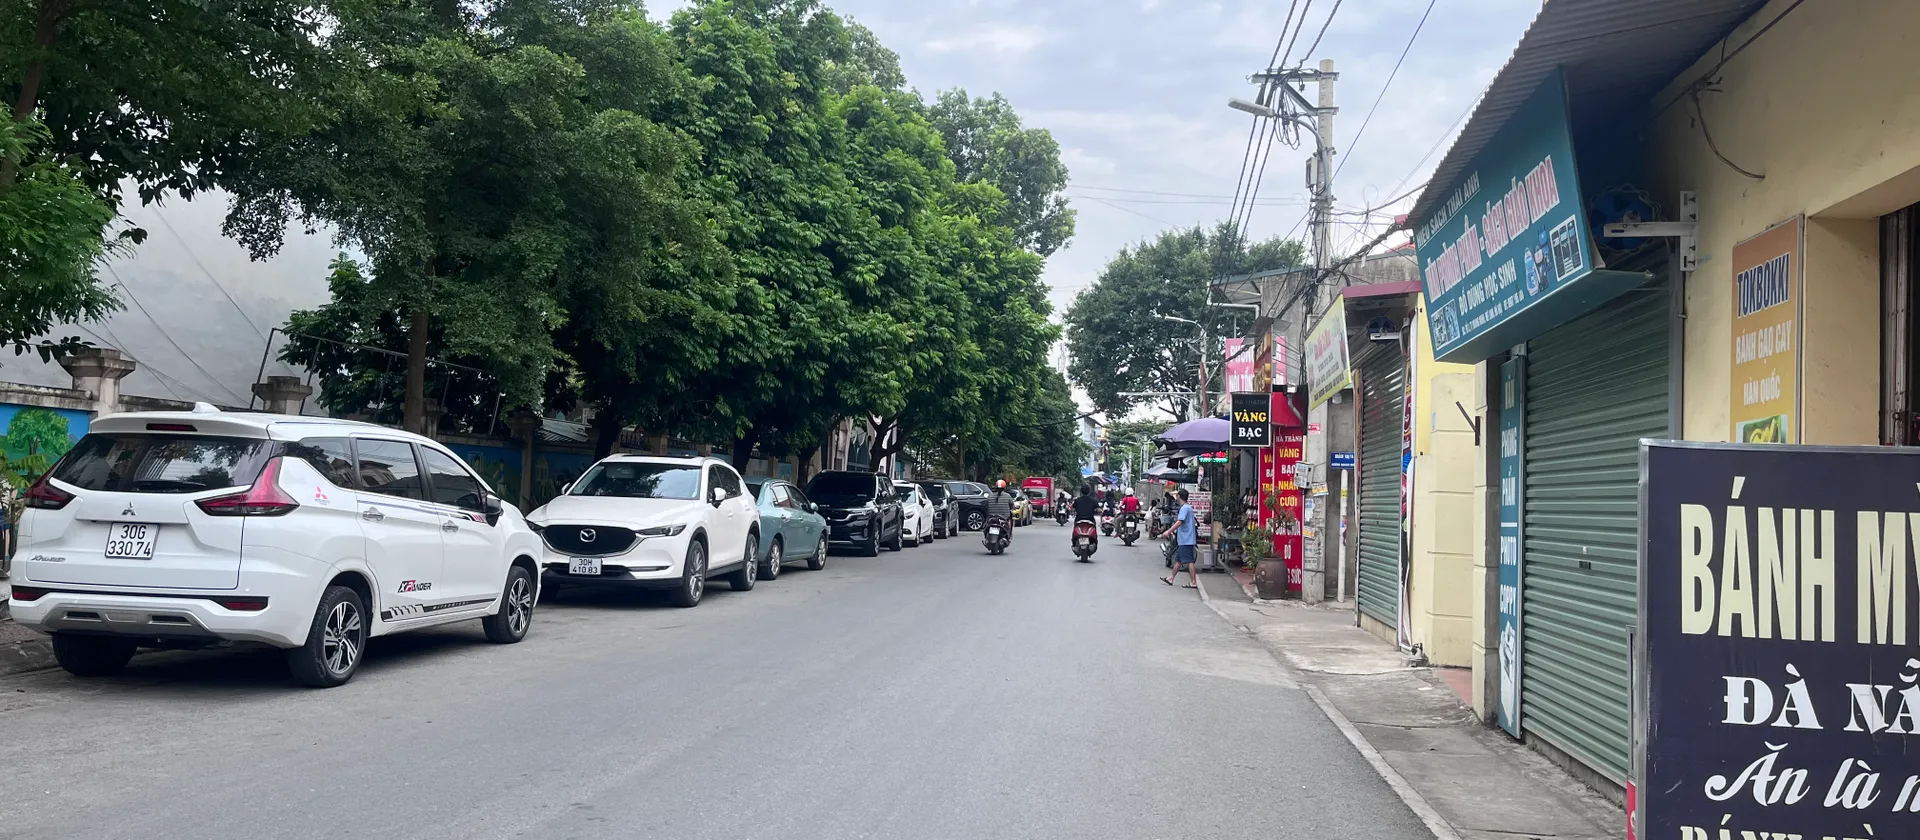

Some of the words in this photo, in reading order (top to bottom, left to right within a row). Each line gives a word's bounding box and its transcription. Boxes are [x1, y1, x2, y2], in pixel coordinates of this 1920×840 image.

[1429, 211, 1448, 235] SÁCH
[1447, 188, 1463, 217] THÁI
[1464, 170, 1480, 202] ANH
[1482, 200, 1510, 259] SÁCH
[1504, 175, 1531, 241] GIÁO
[1525, 154, 1560, 225] KHOA
[1467, 282, 1486, 311] DÙNG
[1483, 271, 1499, 301] HỌC
[1498, 257, 1517, 290] SINH
[1737, 251, 1790, 319] TOKBOKKI
[1736, 328, 1757, 365] BÁNH
[1758, 325, 1774, 364] GẠO
[1775, 319, 1792, 354] CAY
[1743, 377, 1759, 406] HÀN
[1760, 367, 1781, 405] QUỐC
[1234, 409, 1267, 422] VÀNG
[1238, 427, 1262, 440] BẠC
[1279, 446, 1300, 458] VÀNG
[1501, 422, 1517, 459] PHÒNG
[1502, 465, 1516, 507] PHẨM
[107, 541, 151, 557] 330.74
[120, 524, 147, 539] 30G
[1500, 535, 1517, 567] PHOTO
[578, 558, 593, 566] 30H
[1680, 475, 1837, 643] BÁNH
[1720, 662, 1824, 731] ĐÀ
[1704, 740, 1812, 807] Ăn
[1823, 756, 1881, 813] là
